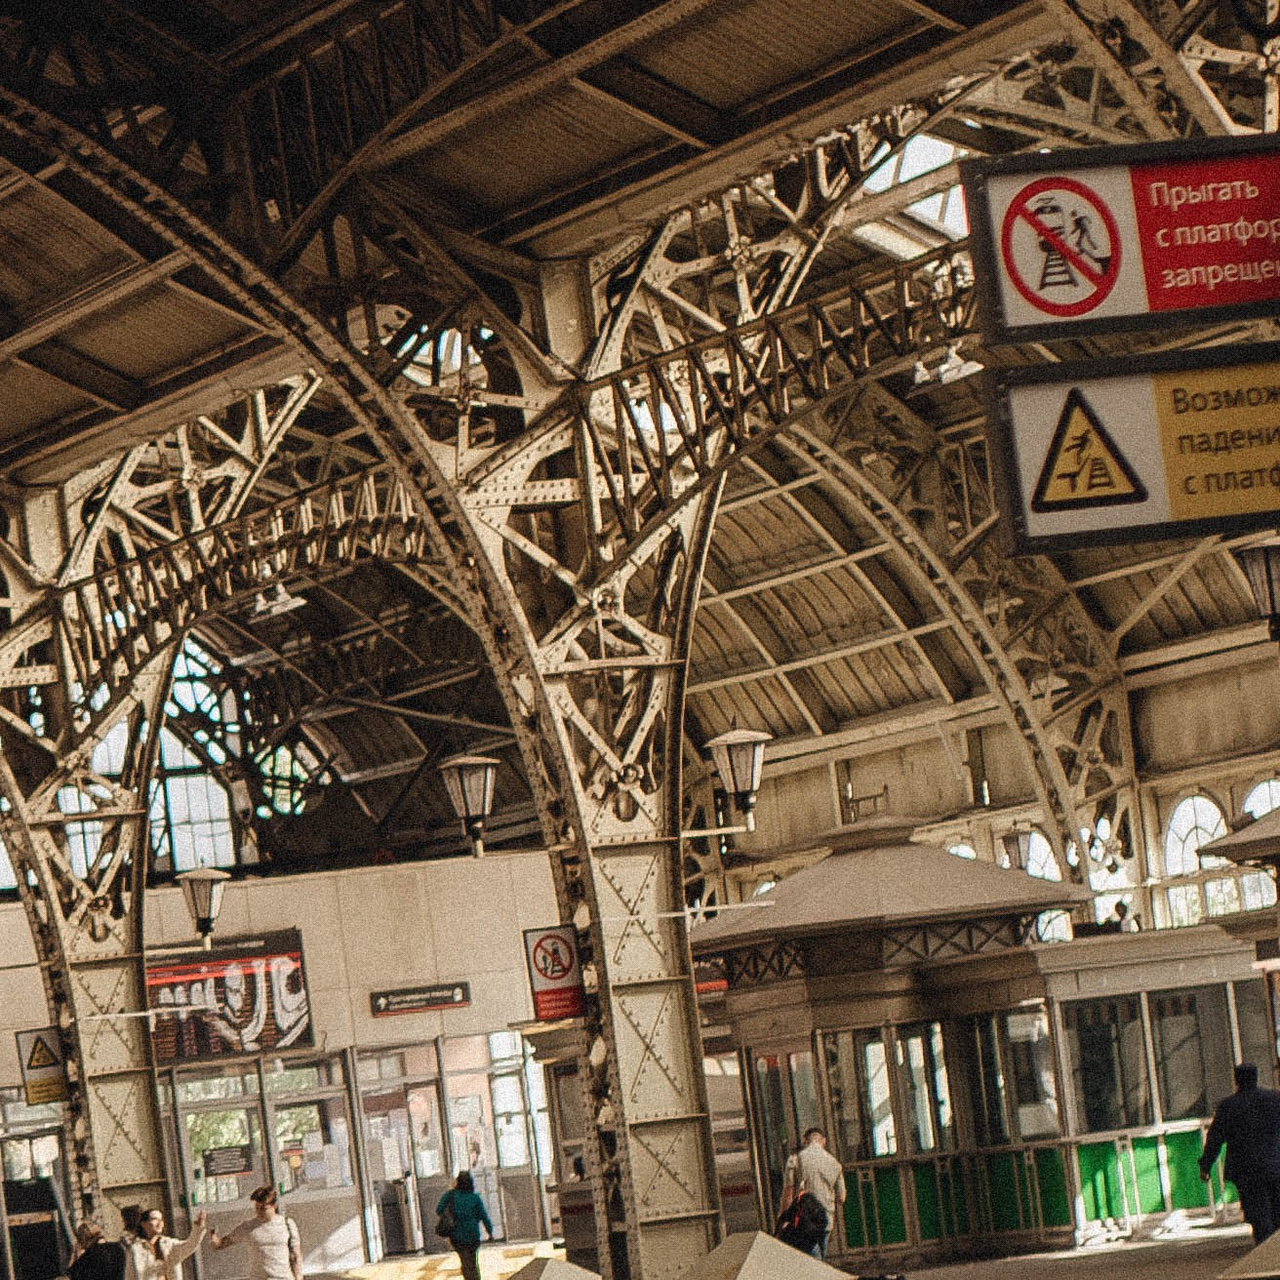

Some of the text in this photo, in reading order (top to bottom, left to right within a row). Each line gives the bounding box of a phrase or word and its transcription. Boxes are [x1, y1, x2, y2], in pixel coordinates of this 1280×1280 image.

[1149, 179, 1259, 212] Прыгать
[1155, 228, 1170, 247] с
[1161, 260, 1280, 291] запреще
[1183, 475, 1199, 495] с
